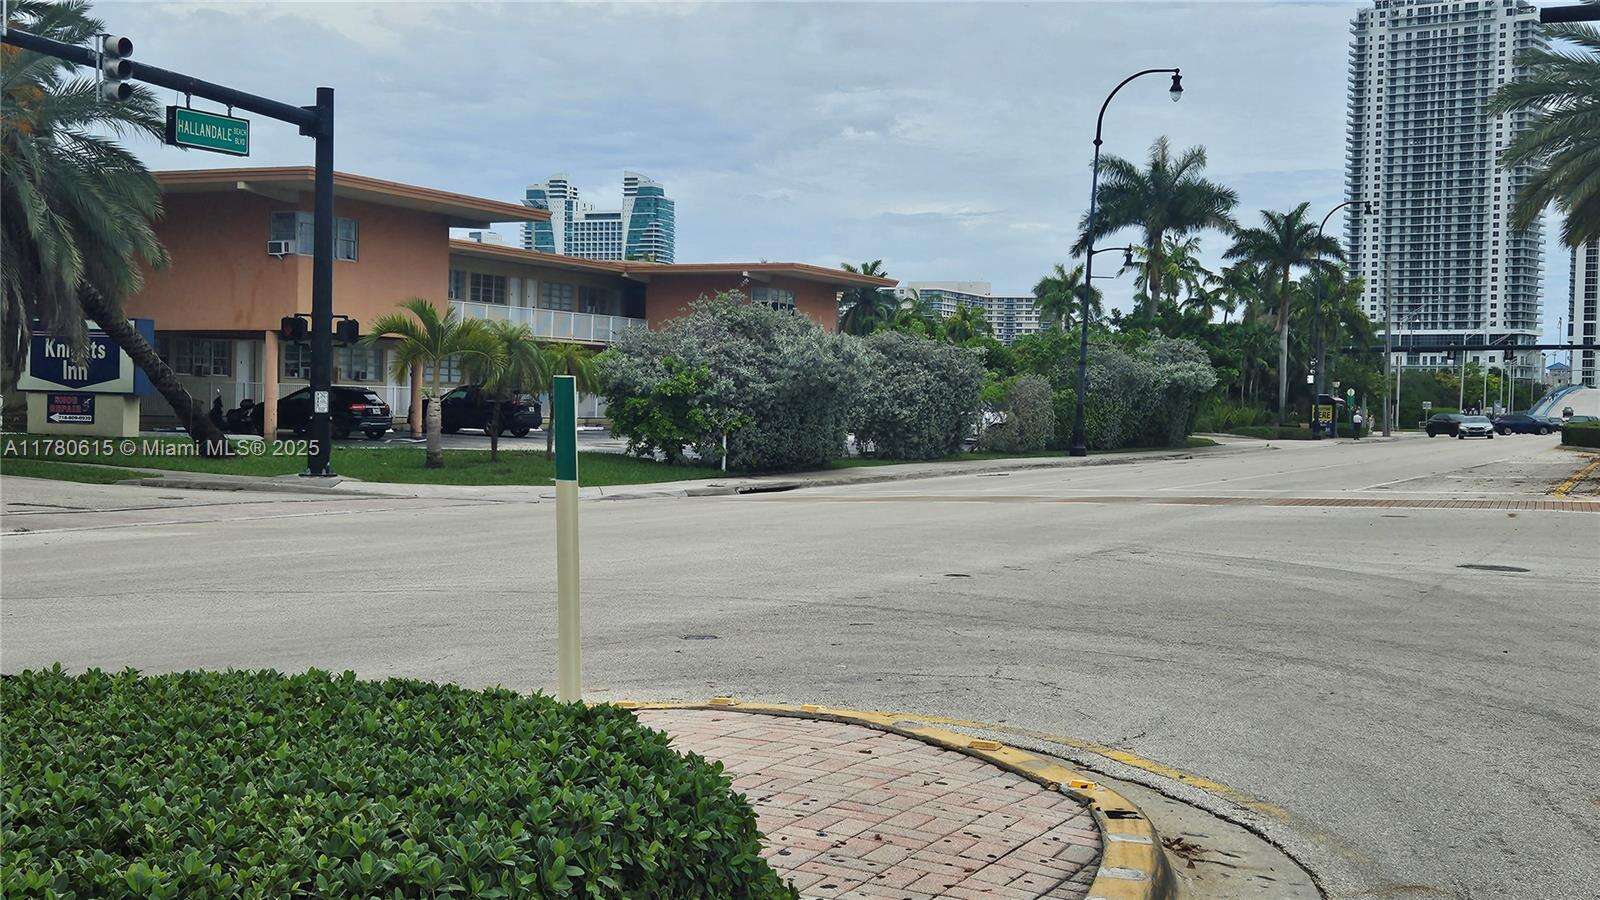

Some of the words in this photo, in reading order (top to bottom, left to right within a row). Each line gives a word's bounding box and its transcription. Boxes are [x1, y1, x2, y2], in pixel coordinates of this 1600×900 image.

[178, 120, 232, 142] HALLANDALE
[233, 127, 247, 136] BEACH
[234, 137, 246, 146] BLVD
[45, 338, 106, 359] Knits
[63, 359, 88, 380] Inn
